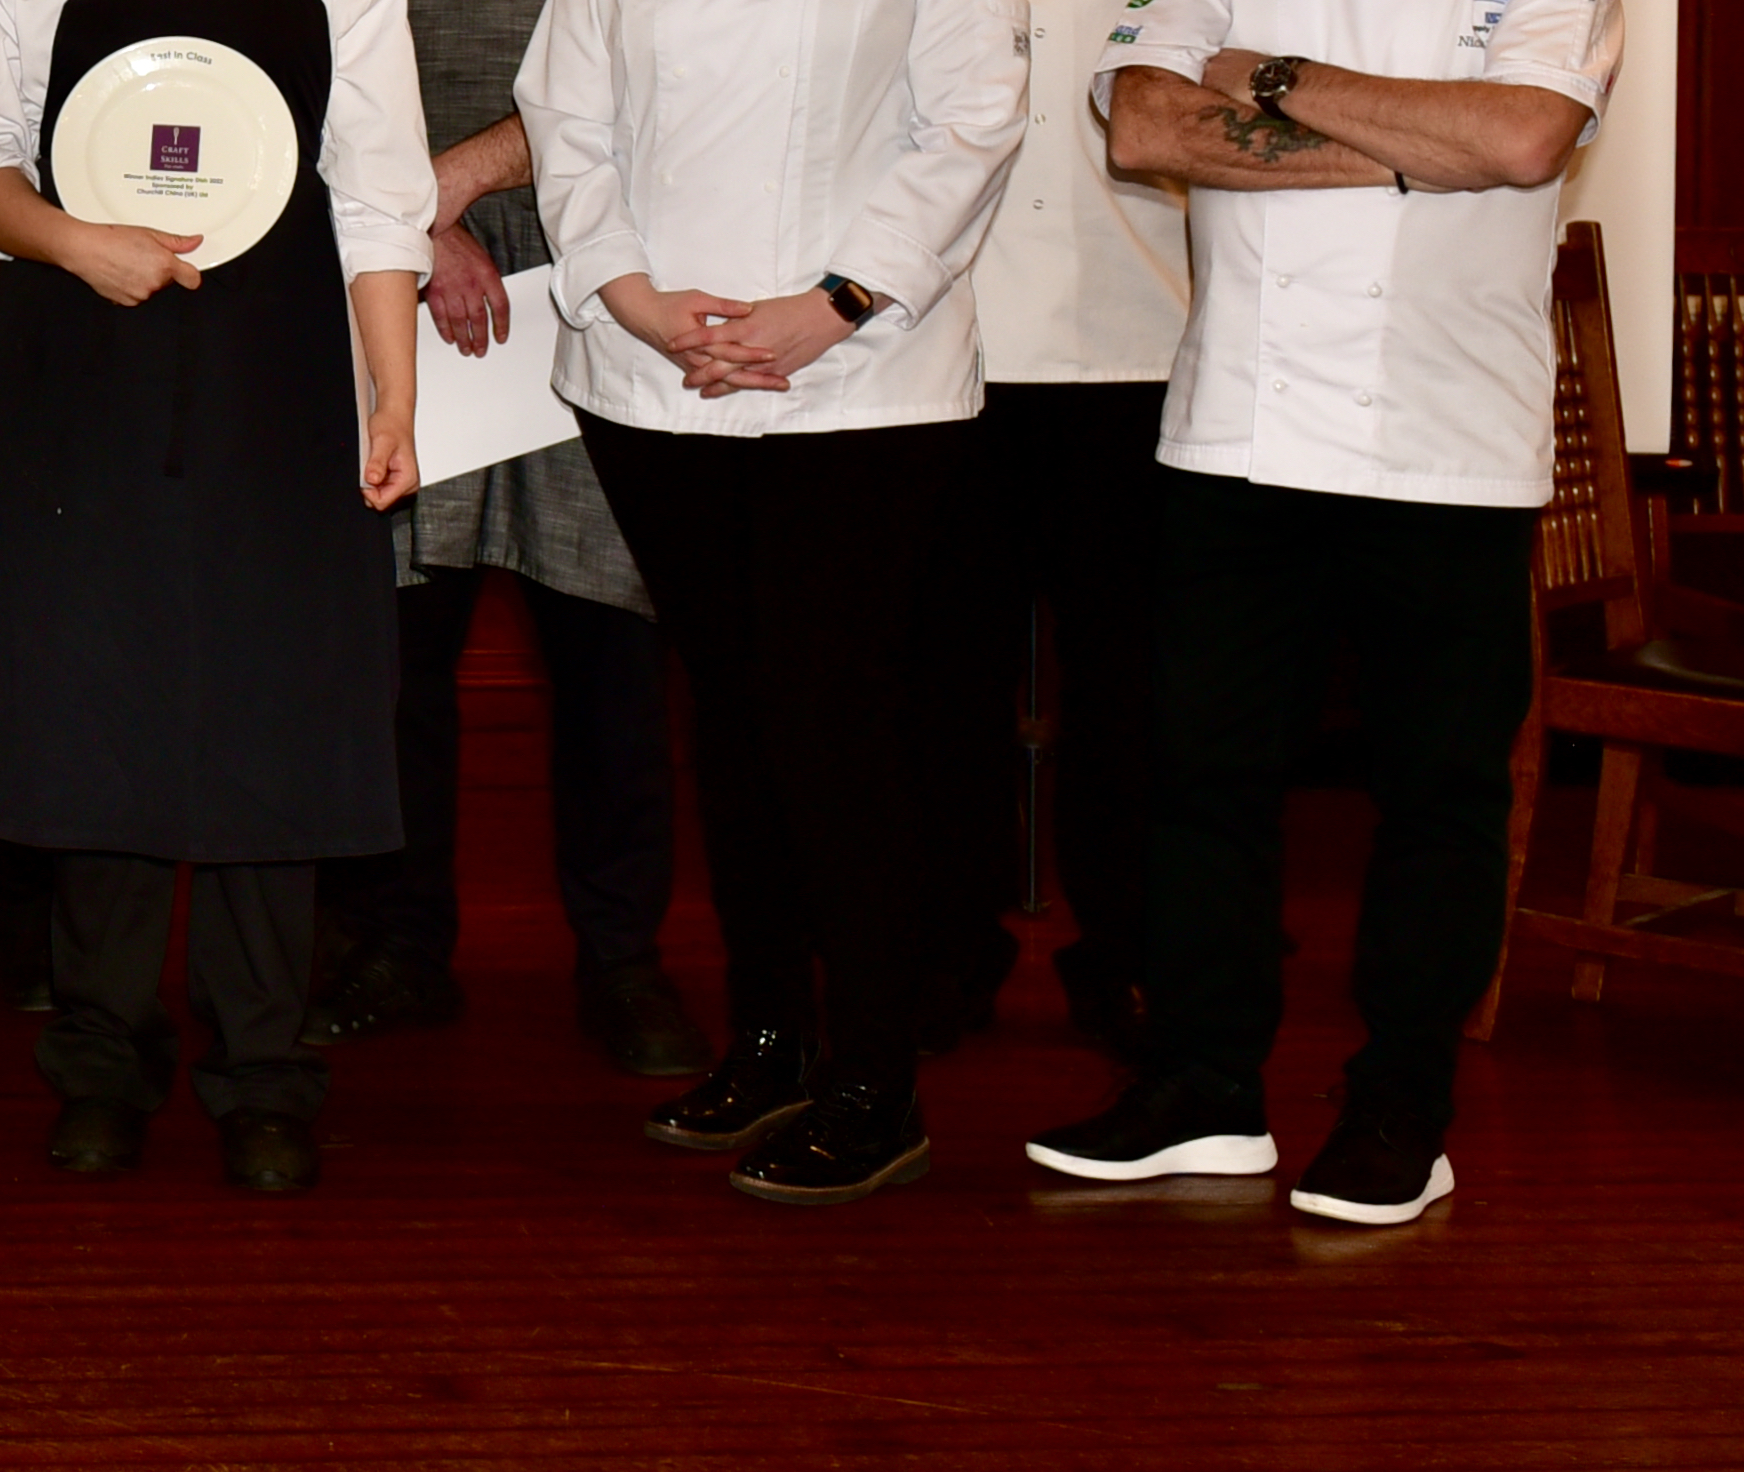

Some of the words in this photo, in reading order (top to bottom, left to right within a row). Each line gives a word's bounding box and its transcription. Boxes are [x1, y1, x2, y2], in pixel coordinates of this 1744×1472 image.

[186, 51, 212, 65] Class
[161, 146, 189, 154] CRAFT
[161, 155, 189, 164] SKILLS
